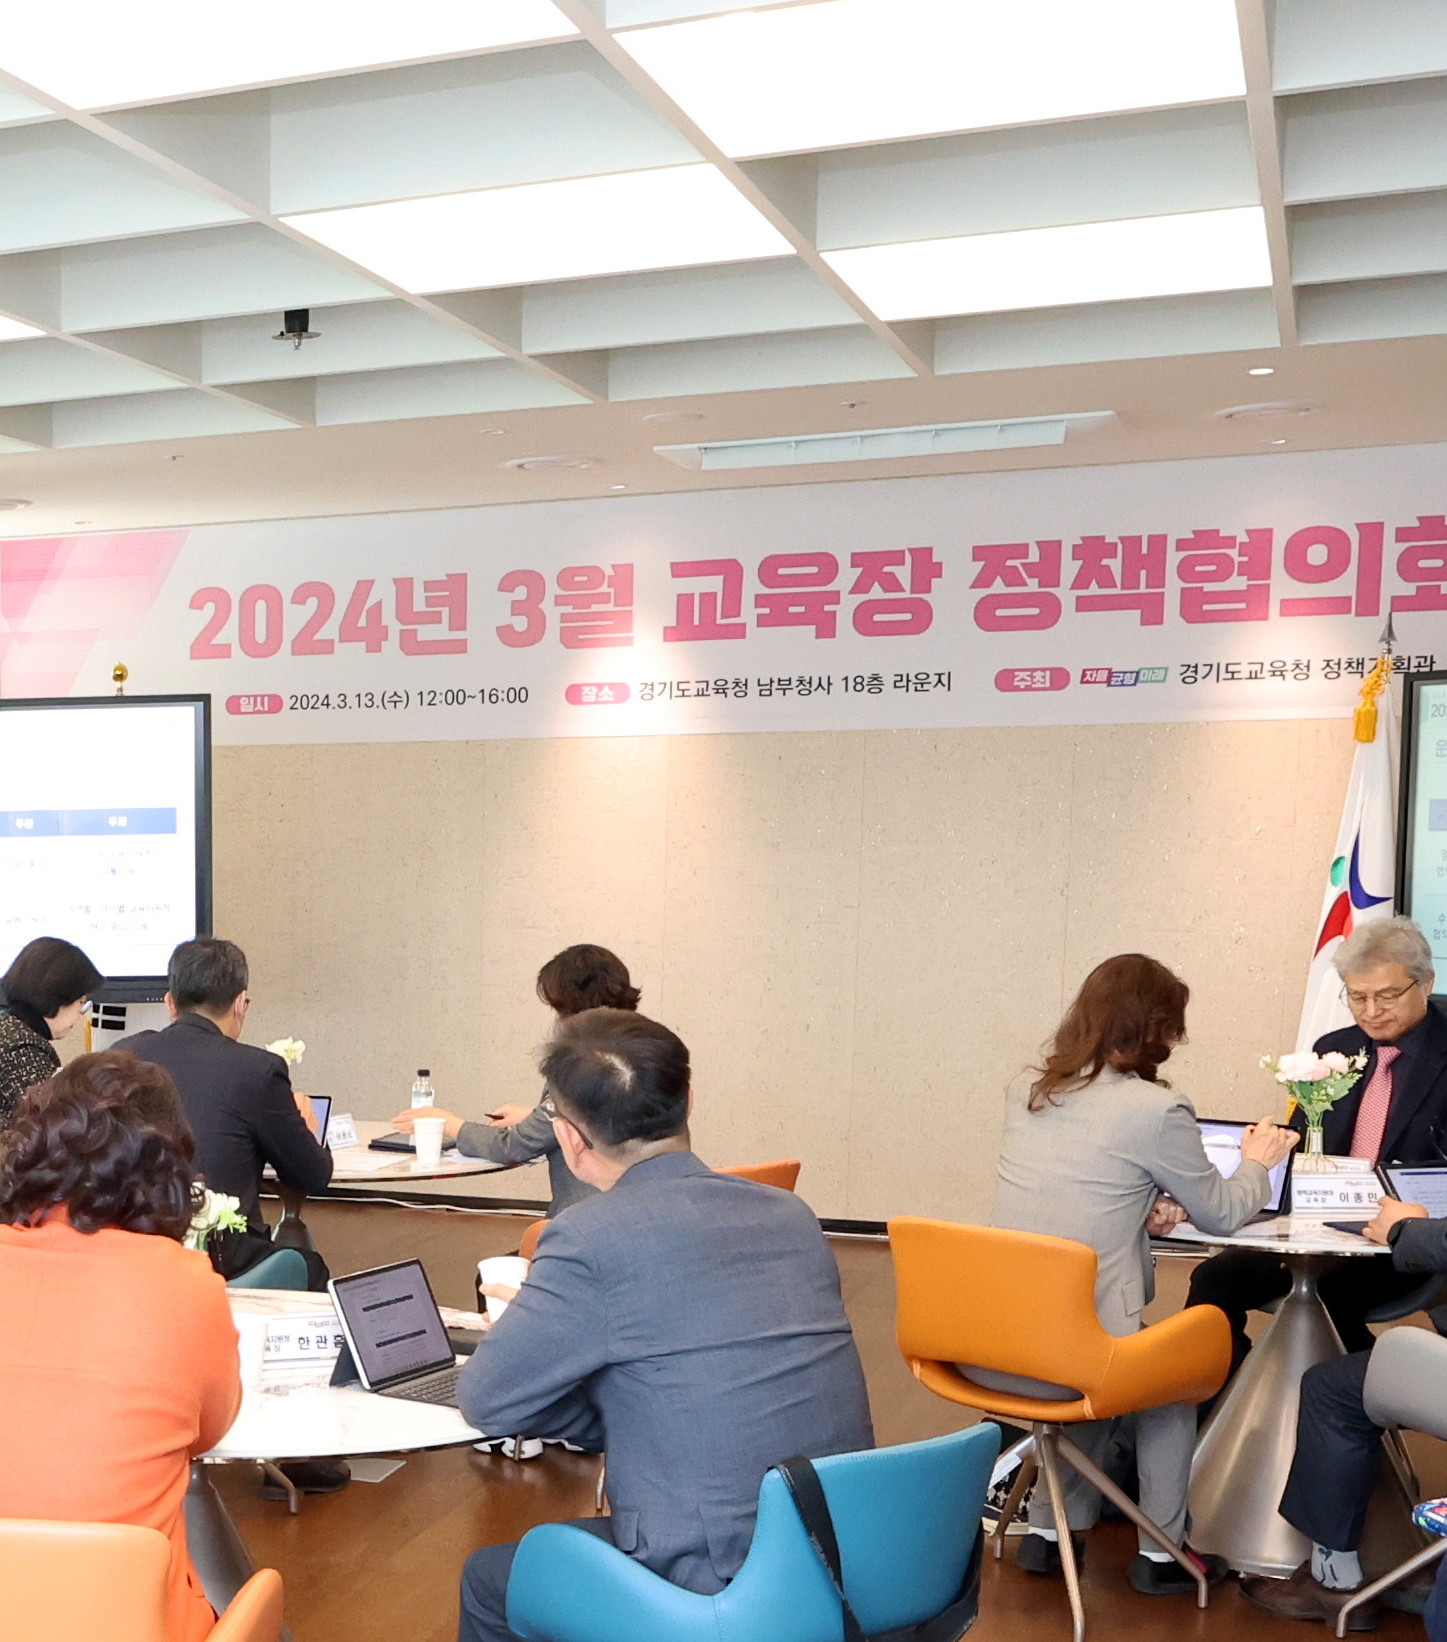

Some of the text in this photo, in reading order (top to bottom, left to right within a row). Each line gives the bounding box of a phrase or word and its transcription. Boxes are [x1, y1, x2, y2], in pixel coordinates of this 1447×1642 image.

[189, 572, 468, 660] 2024년
[495, 562, 635, 649] 3월
[662, 547, 944, 643] 교육장
[1013, 668, 1052, 690] 주최
[1178, 658, 1310, 683] 경기도교육청
[580, 684, 616, 704] 장소
[638, 671, 953, 701] 경기도교육청 남부청사 18층 라운지
[237, 694, 270, 712] 일시
[289, 686, 530, 712] 2024.3.13.(수) 12:00~16:00
